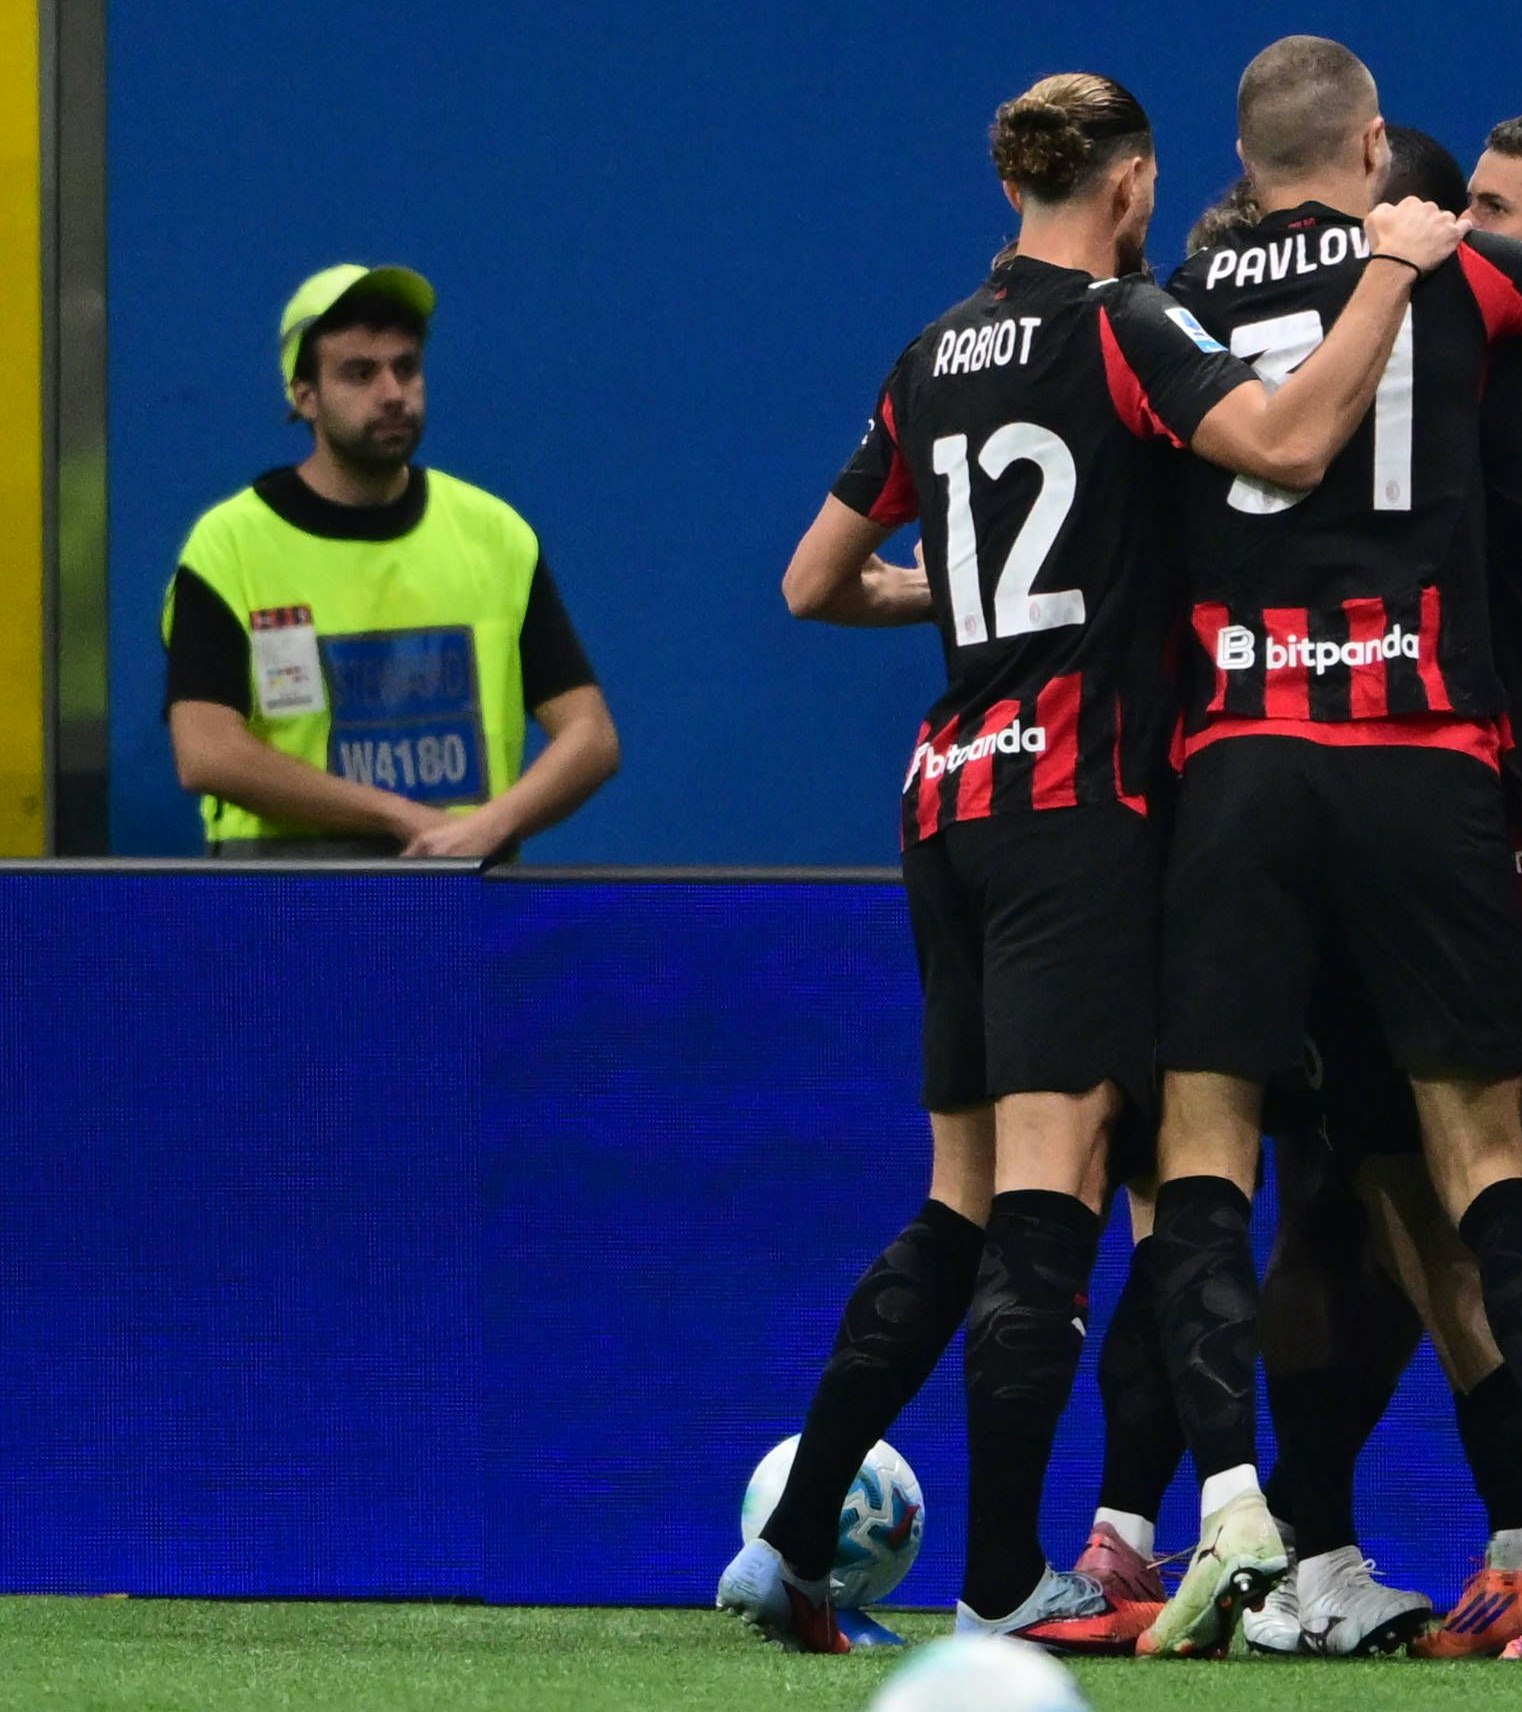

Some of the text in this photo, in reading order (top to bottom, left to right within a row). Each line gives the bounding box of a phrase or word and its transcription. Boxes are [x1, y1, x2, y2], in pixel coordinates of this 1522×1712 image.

[933, 317, 1041, 377] RABIOT
[932, 421, 1086, 647] 12
[1266, 623, 1420, 675] bitpanda
[340, 733, 467, 789] W4180
